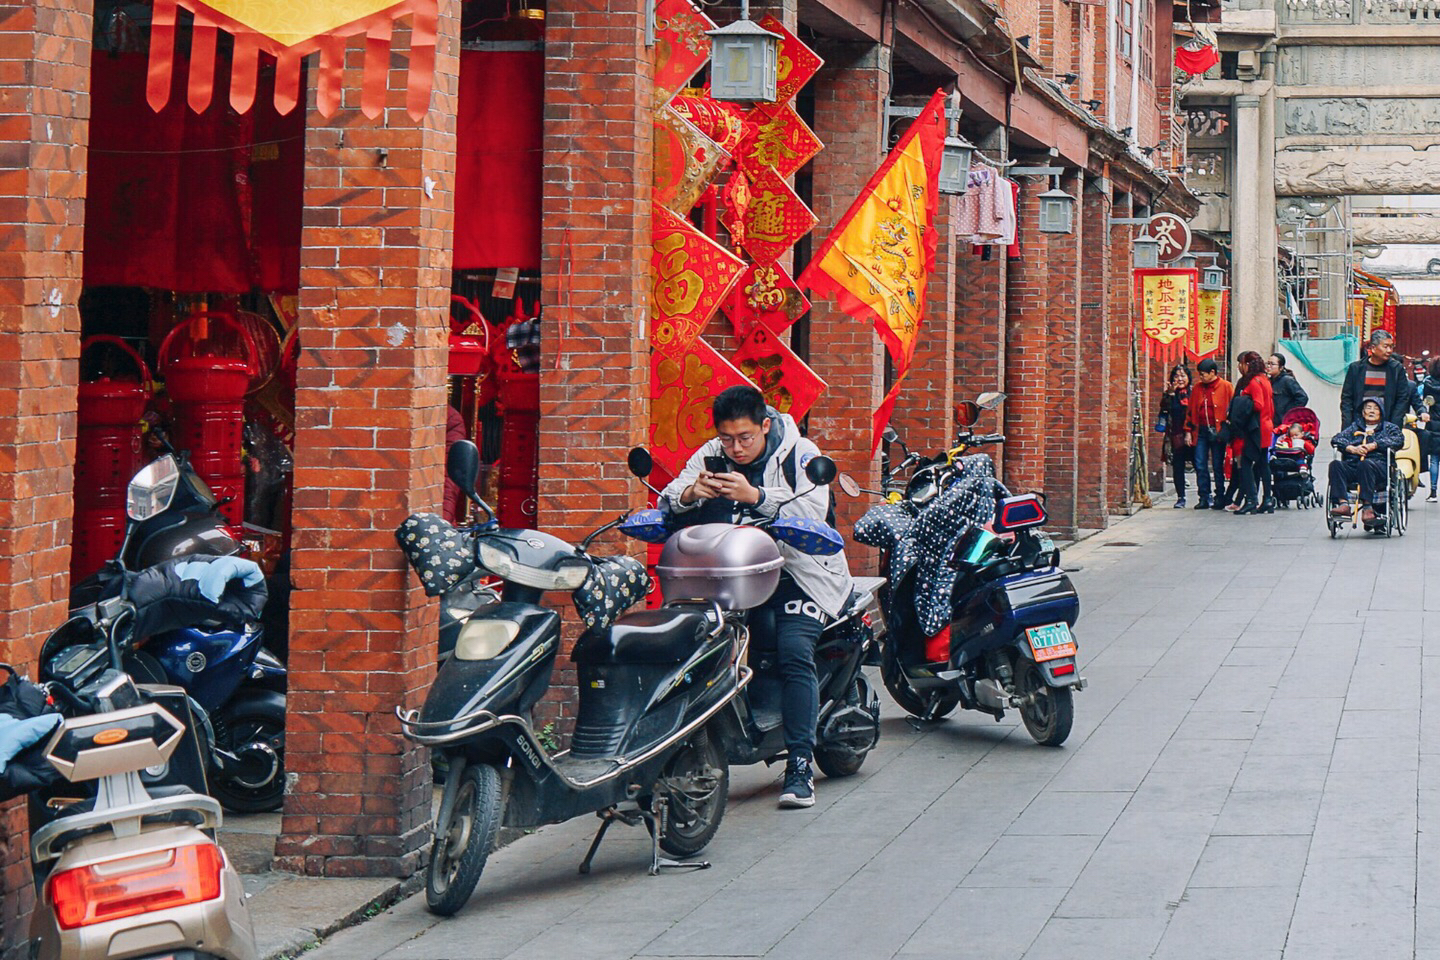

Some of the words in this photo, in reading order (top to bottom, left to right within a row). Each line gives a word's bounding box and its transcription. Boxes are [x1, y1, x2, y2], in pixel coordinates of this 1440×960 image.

[747, 117, 798, 168] 春
[1154, 218, 1183, 256] 茶
[1157, 278, 1175, 330] 地瓜王子
